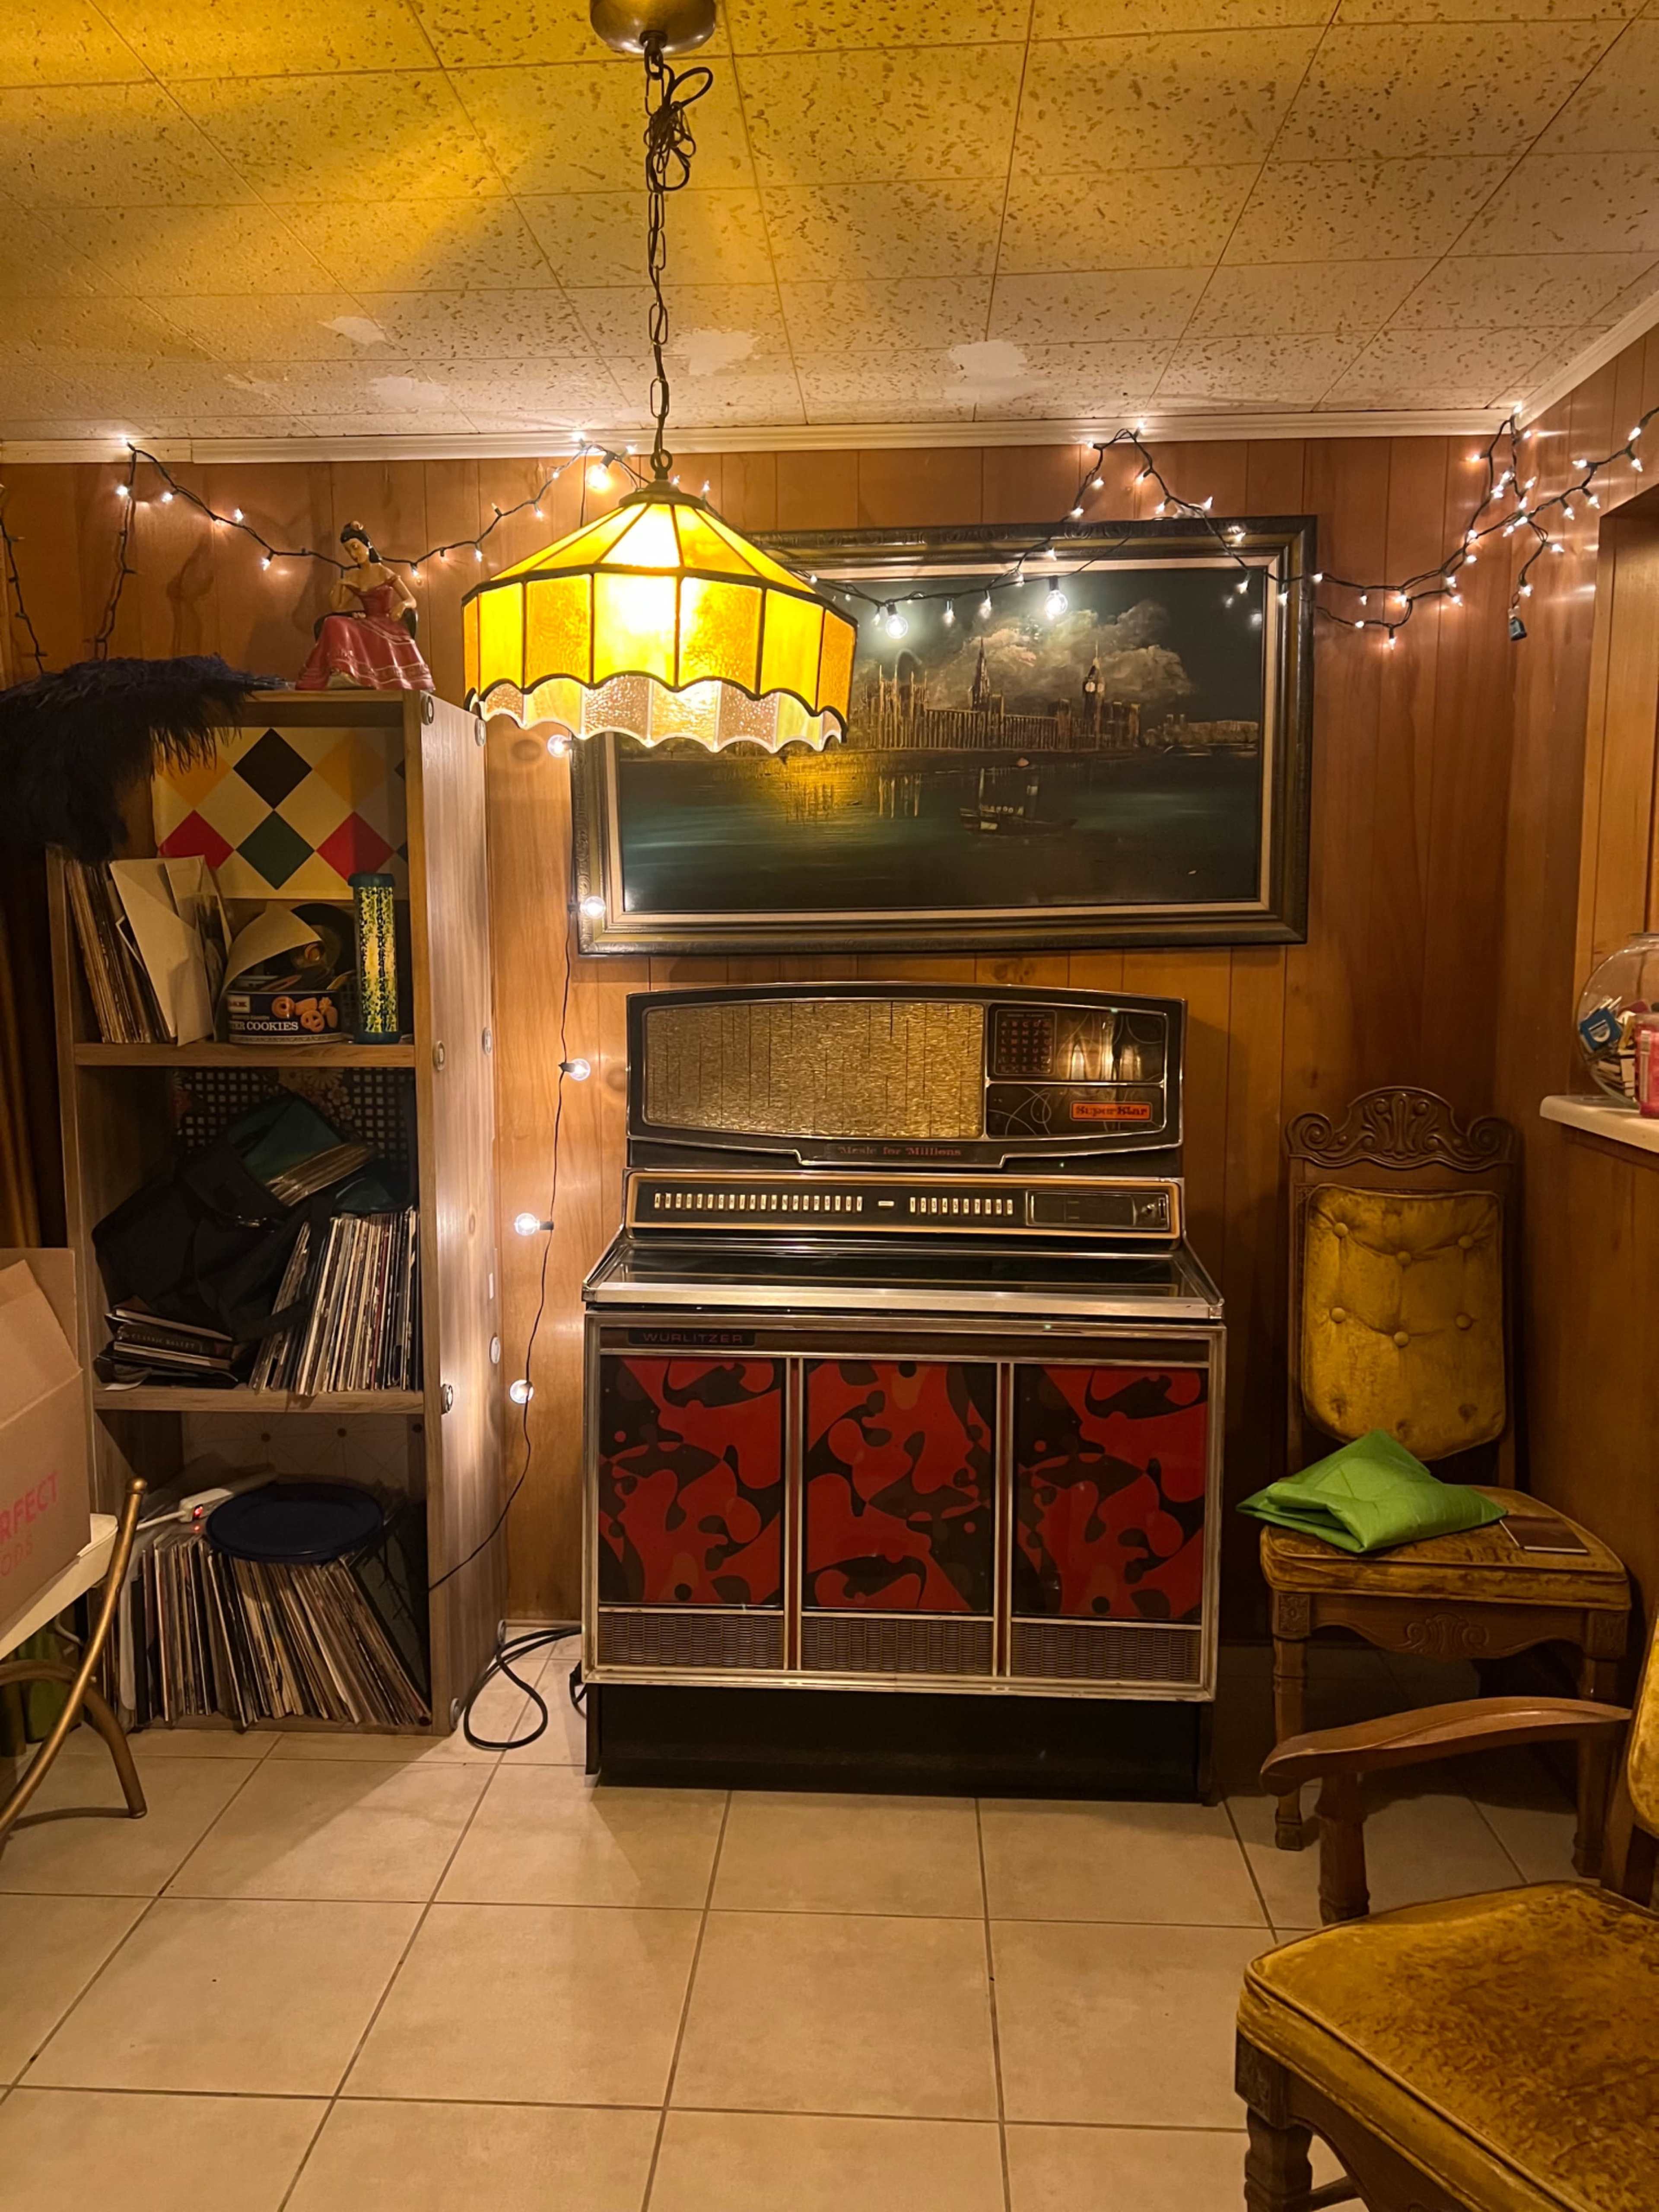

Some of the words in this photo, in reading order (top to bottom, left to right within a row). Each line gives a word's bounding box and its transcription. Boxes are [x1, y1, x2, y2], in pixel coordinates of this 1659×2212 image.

[246, 1021, 299, 1031] COOKIES
[883, 1146, 900, 1155] for
[905, 1146, 962, 1156] Millions
[642, 1332, 744, 1344] WURLITZER
